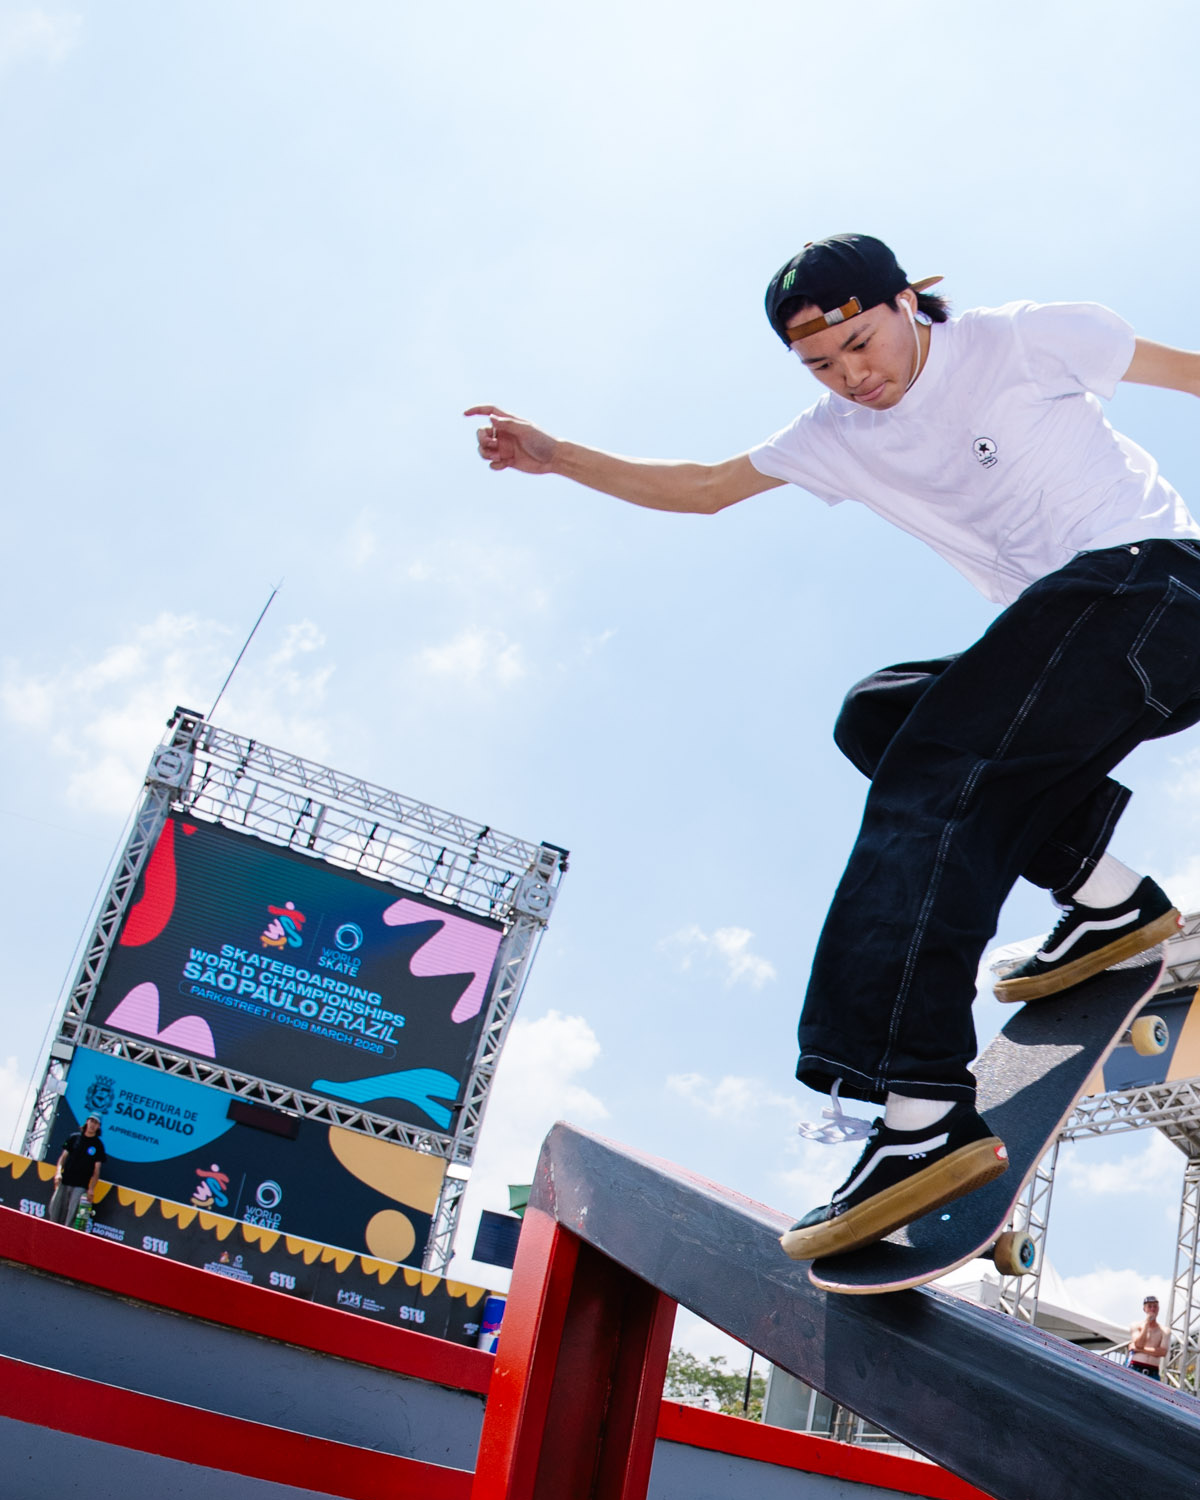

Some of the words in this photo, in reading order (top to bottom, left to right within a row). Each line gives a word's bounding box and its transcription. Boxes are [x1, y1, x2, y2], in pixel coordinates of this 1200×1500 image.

[318, 957, 358, 977] SKATE
[322, 947, 361, 967] WORLD
[220, 944, 382, 1006] SKATEBOARDING
[189, 948, 256, 979] WORLD
[259, 971, 406, 1028] CHAMPIONSHIPS
[183, 961, 237, 991] SÃO
[238, 979, 319, 1017] PAULO
[319, 1007, 399, 1045] BRAZIL
[190, 985, 270, 1017] PARK/STREET
[278, 1014, 309, 1030] 01-08
[310, 1024, 353, 1044] MARCH
[119, 1089, 181, 1119] PREFEITURA
[184, 1109, 198, 1122] DE
[114, 1101, 145, 1121] SÃO
[146, 1113, 194, 1136] PAULO
[108, 1125, 160, 1145] APRESENTA
[20, 1198, 45, 1217] STU
[246, 1204, 281, 1222] WORLD
[243, 1213, 280, 1230] SKATE
[142, 1236, 169, 1254] STU
[269, 1271, 296, 1290] STU
[399, 1305, 425, 1324] STU
